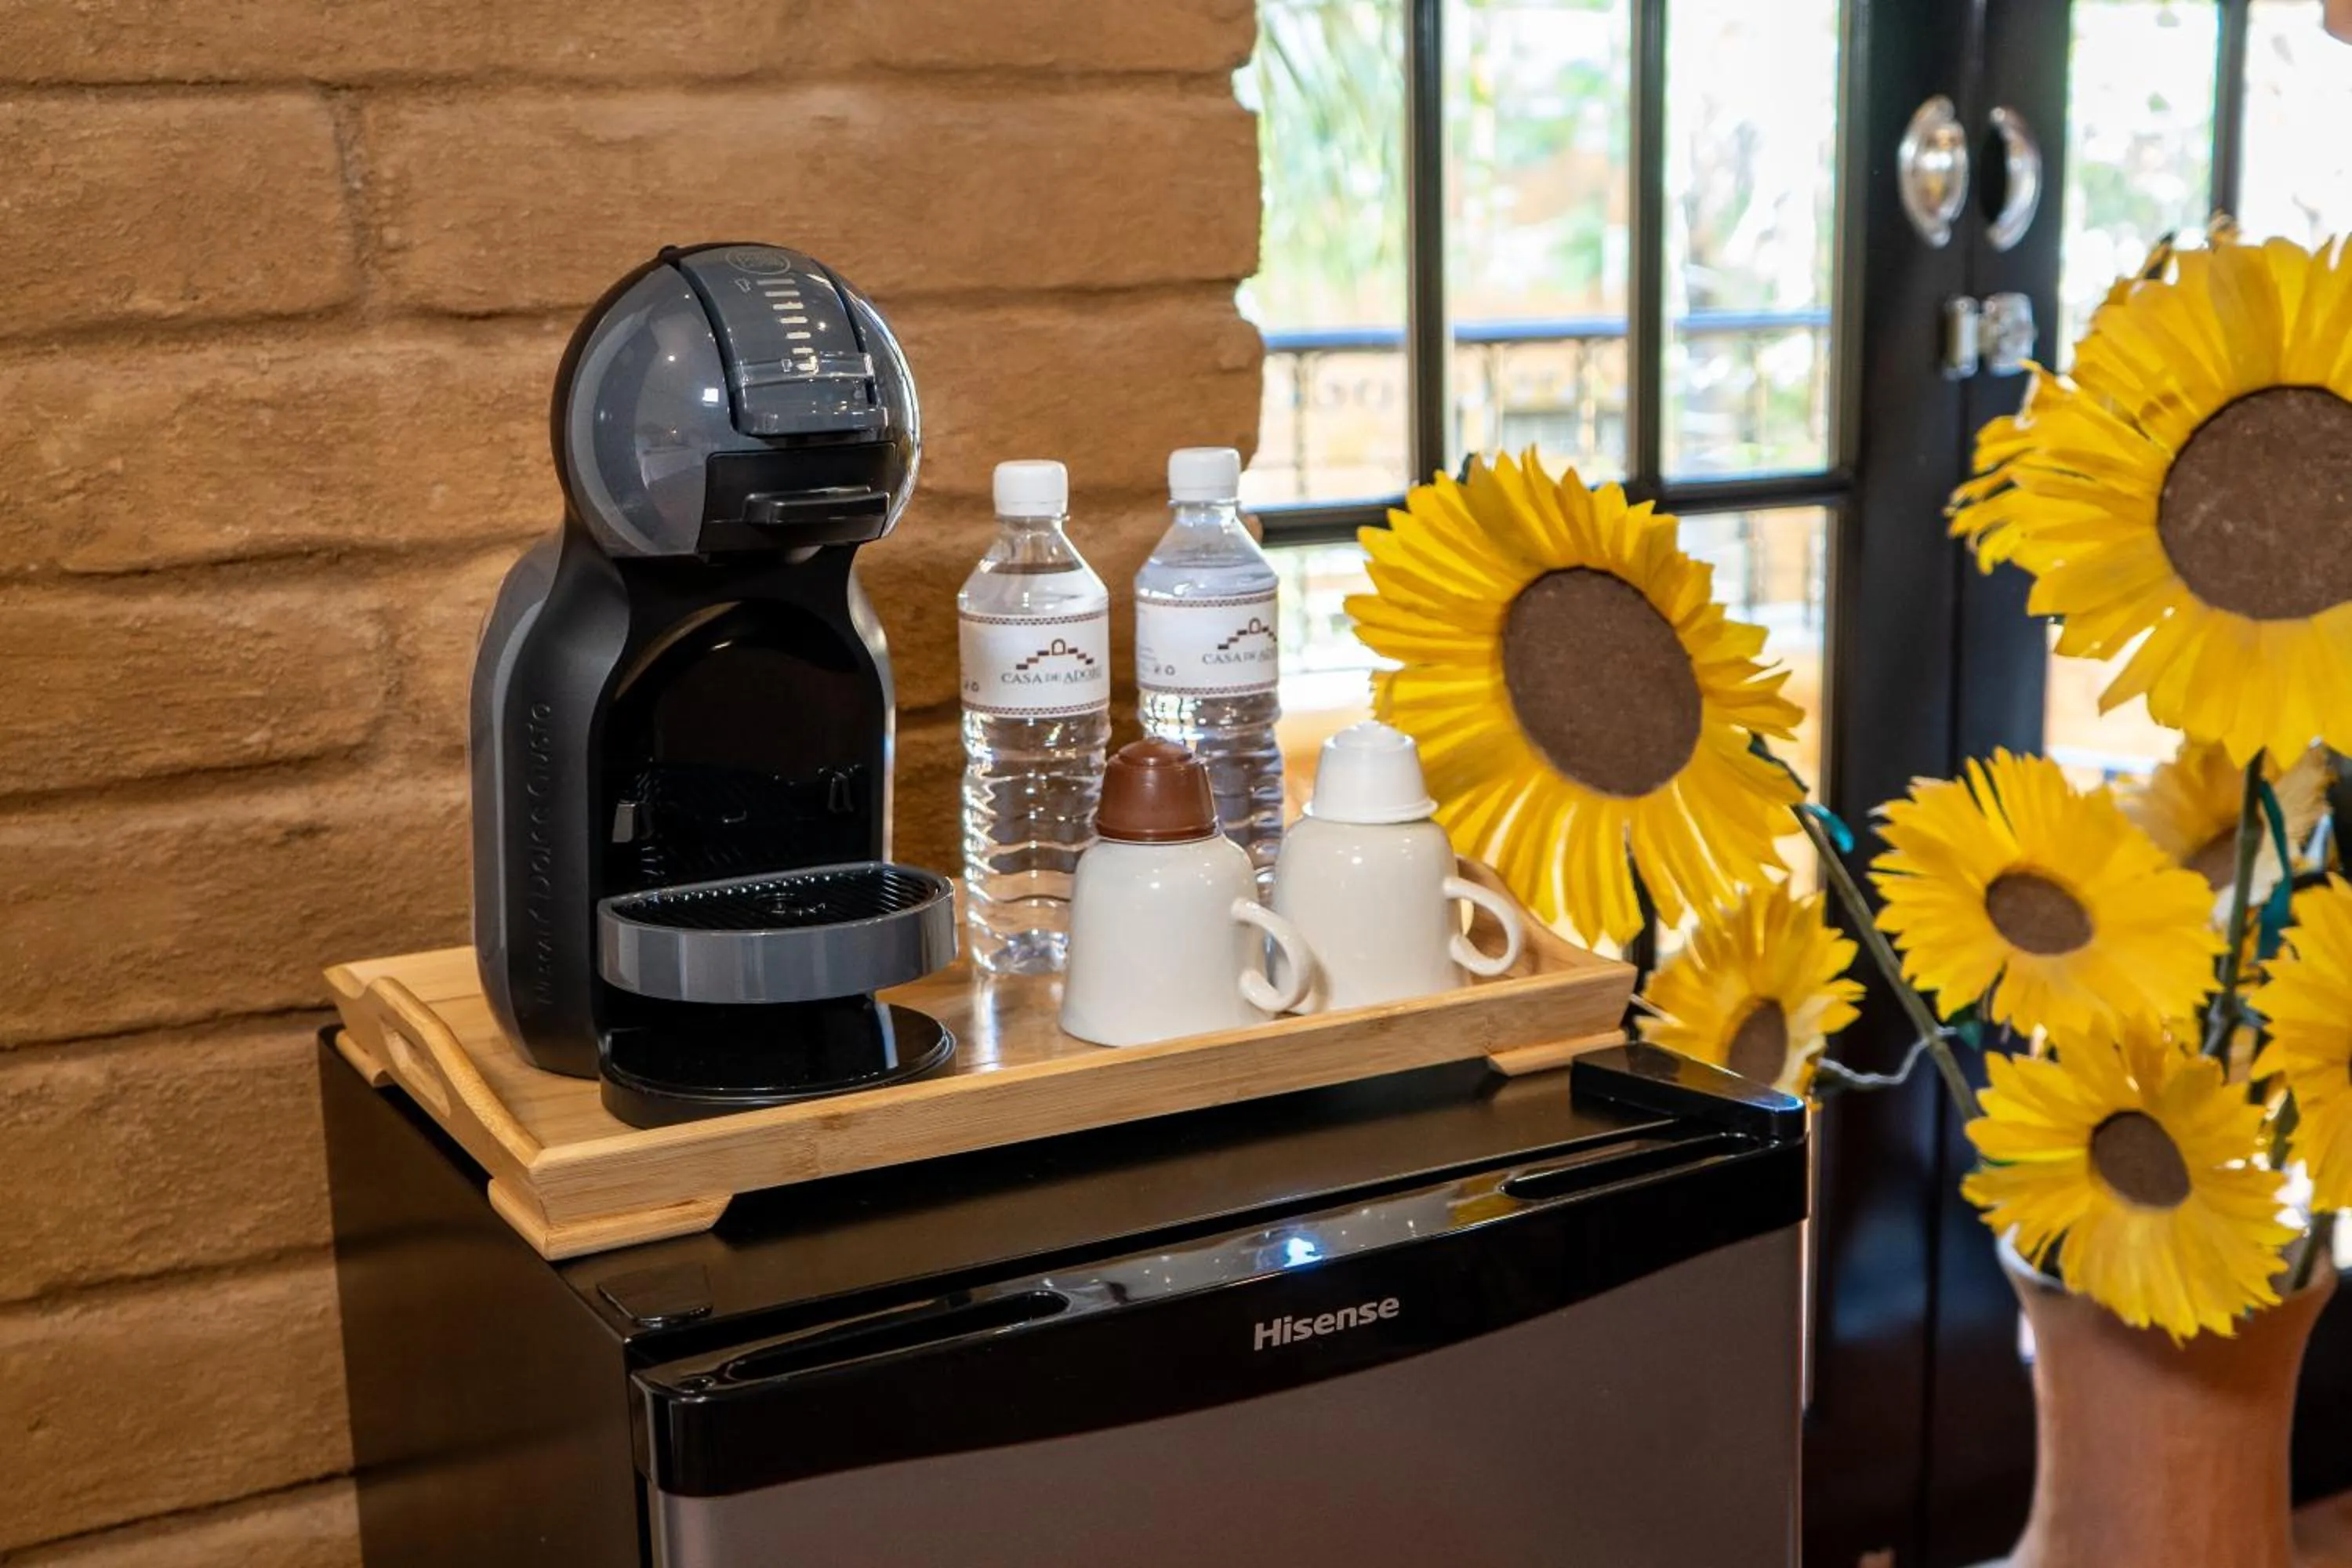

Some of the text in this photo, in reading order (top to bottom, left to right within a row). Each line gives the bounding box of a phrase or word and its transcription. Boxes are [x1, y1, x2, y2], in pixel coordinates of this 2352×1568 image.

[1202, 652, 1242, 665] CASA
[1000, 672, 1042, 684] CASA
[1254, 1297, 1399, 1351] Hisense
